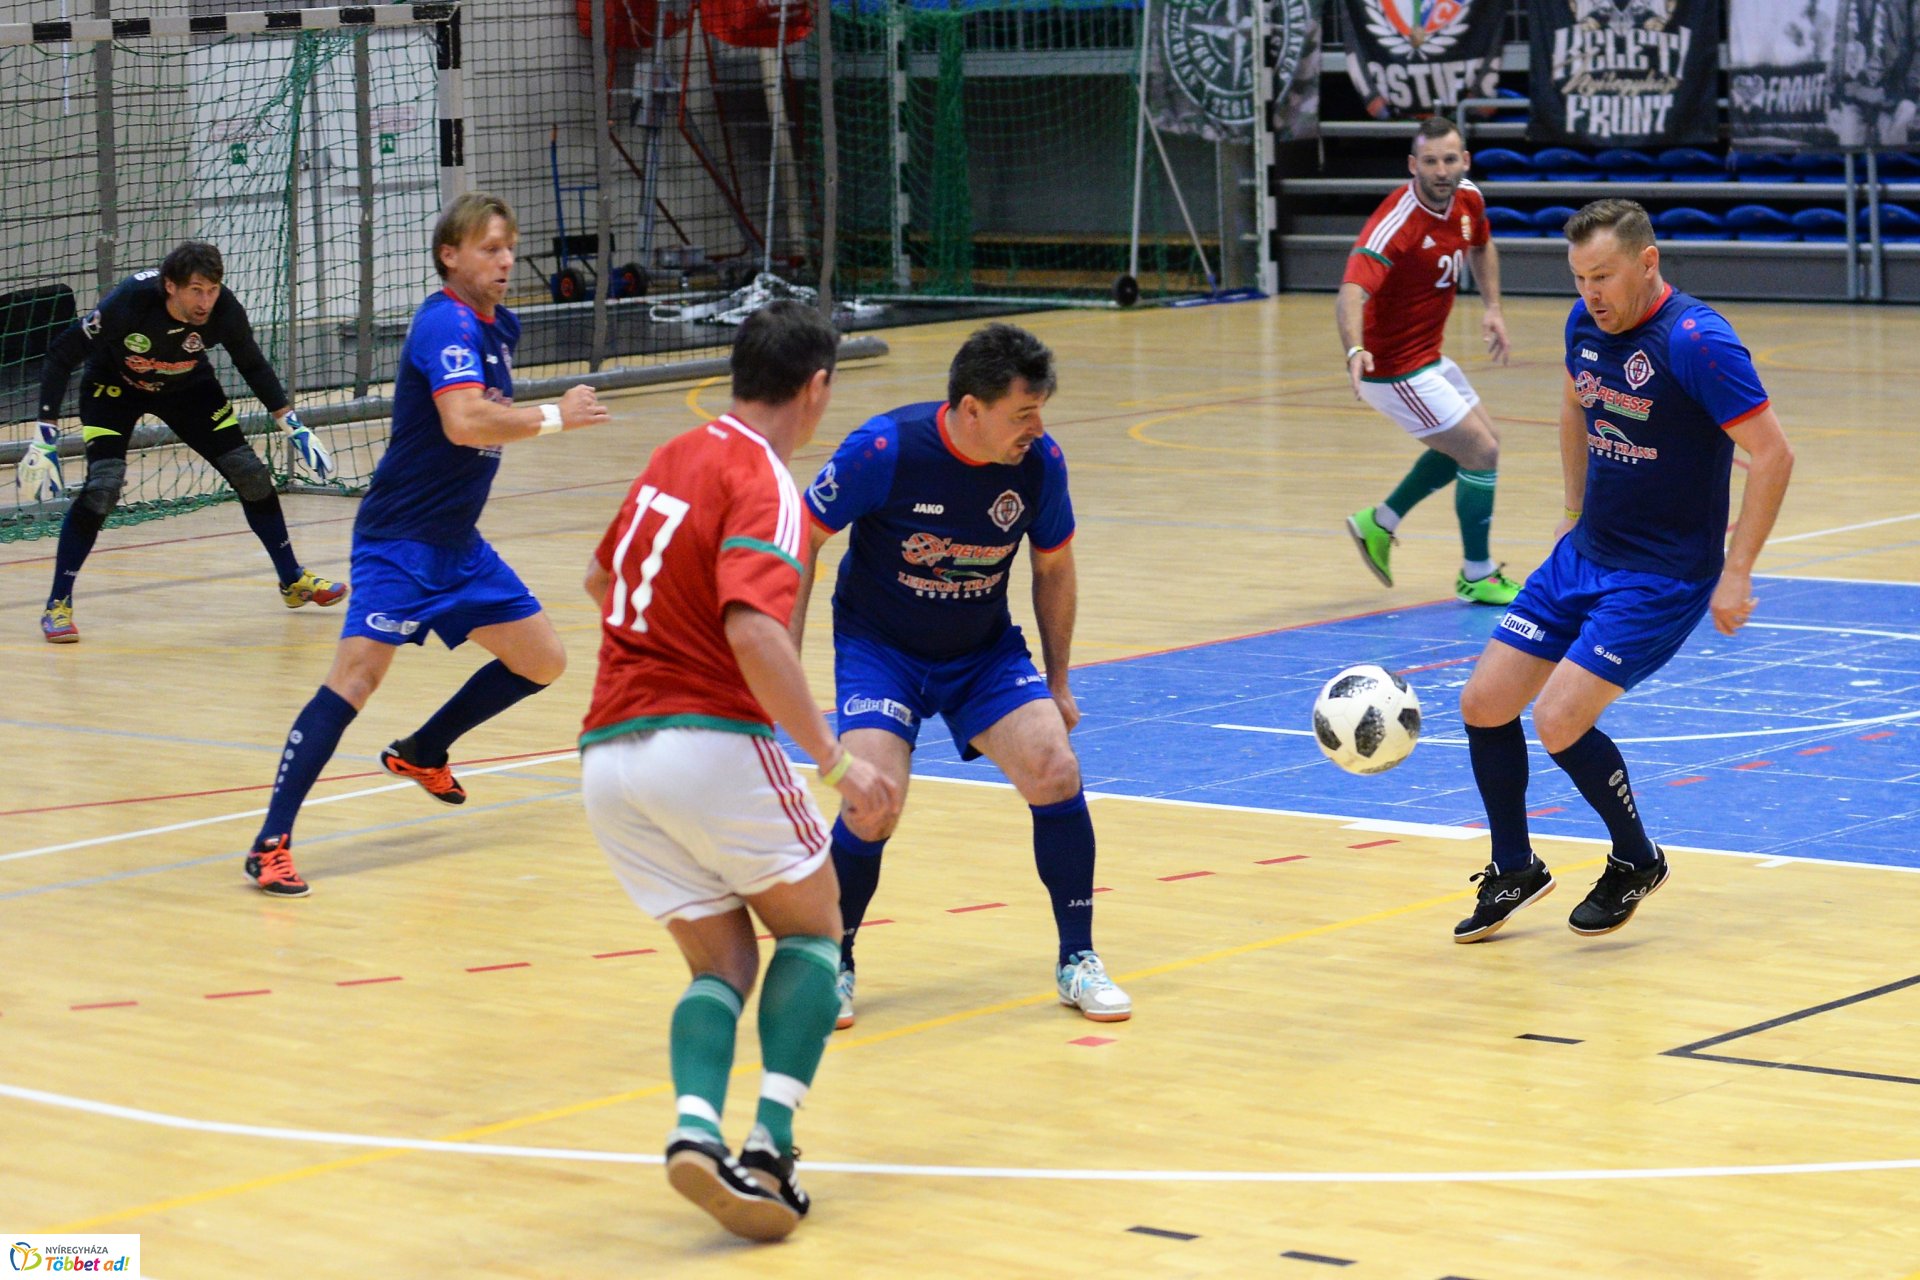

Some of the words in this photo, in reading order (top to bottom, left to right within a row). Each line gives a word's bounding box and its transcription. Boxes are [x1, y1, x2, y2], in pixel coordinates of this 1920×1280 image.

[1565, 94, 1674, 137] FRONT
[1434, 248, 1464, 289] 20
[1581, 348, 1599, 363] JAKO
[1597, 385, 1654, 414] REVESZ
[1613, 440, 1658, 460] TRANS
[912, 502, 944, 515] JAKO
[606, 484, 691, 634] 17
[1602, 650, 1623, 665] JAKO
